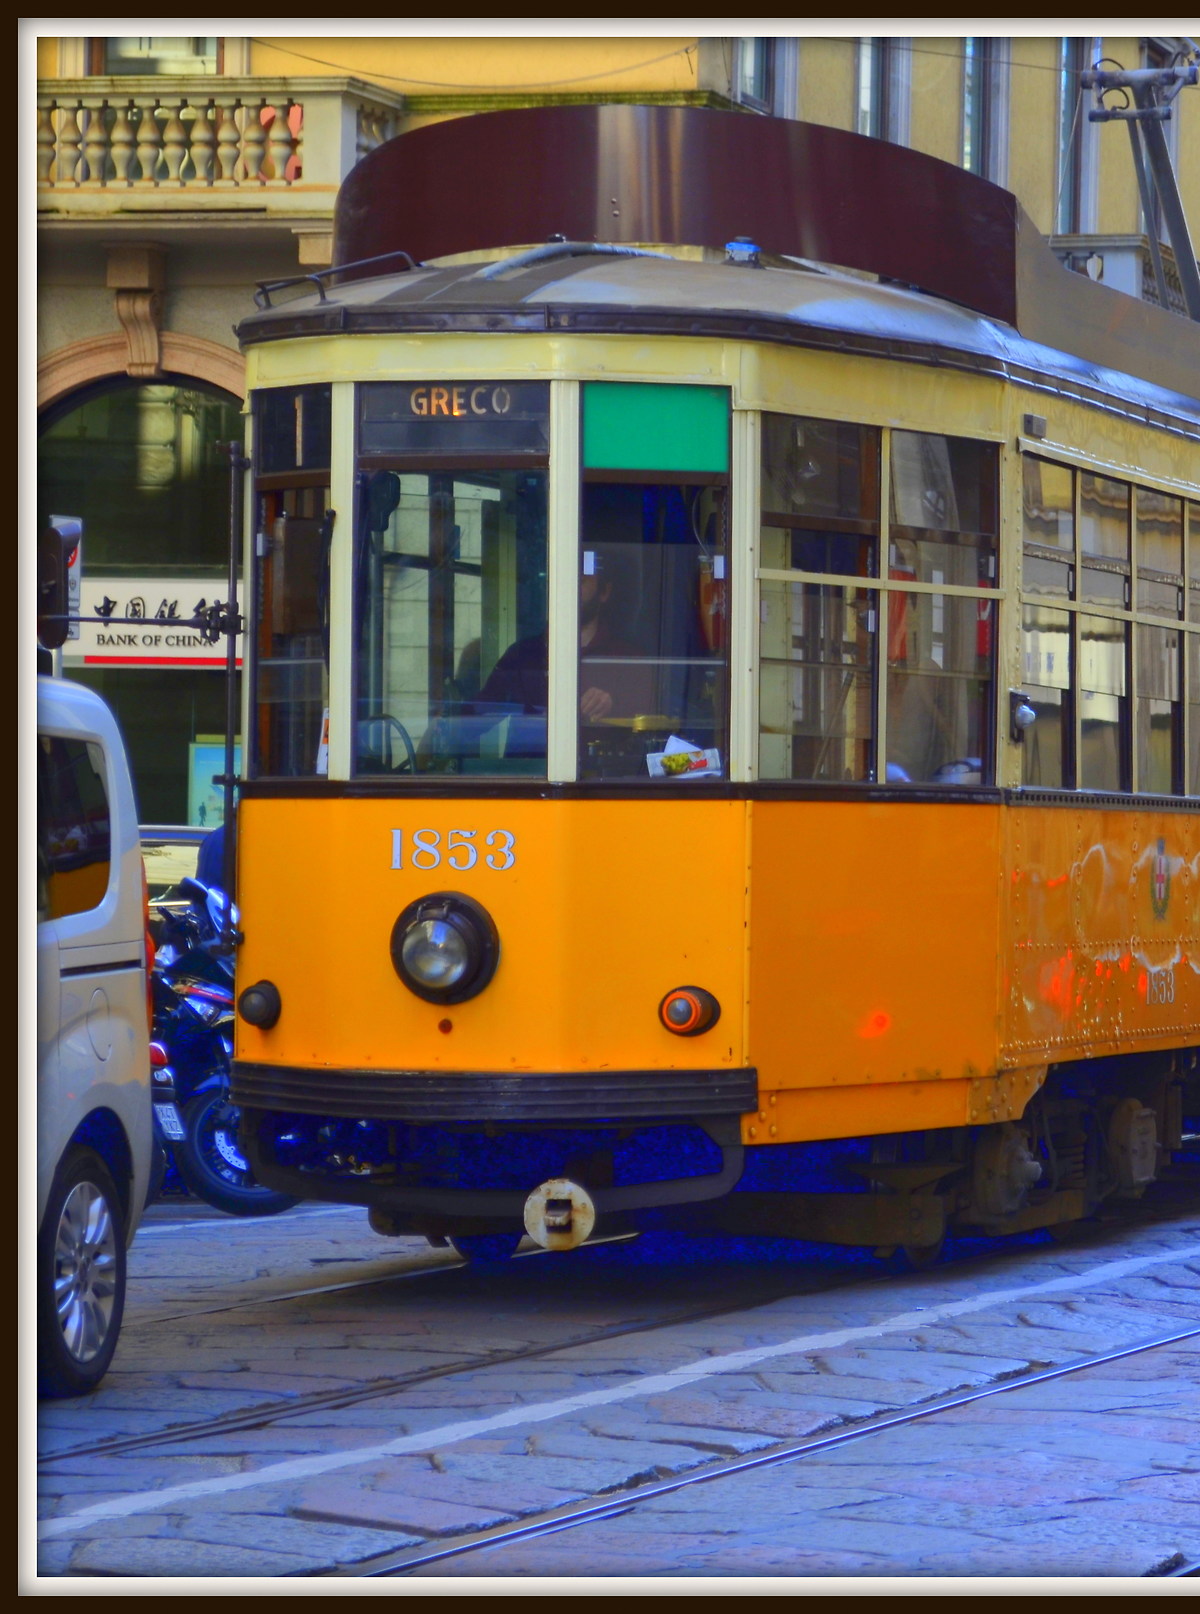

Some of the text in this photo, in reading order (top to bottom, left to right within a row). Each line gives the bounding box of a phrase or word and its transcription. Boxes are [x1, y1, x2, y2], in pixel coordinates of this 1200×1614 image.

[410, 386, 511, 416] GRECO
[96, 634, 138, 647] BANK
[141, 634, 161, 647] OF
[389, 828, 516, 871] 1853
[1146, 969, 1175, 1005] 1853
